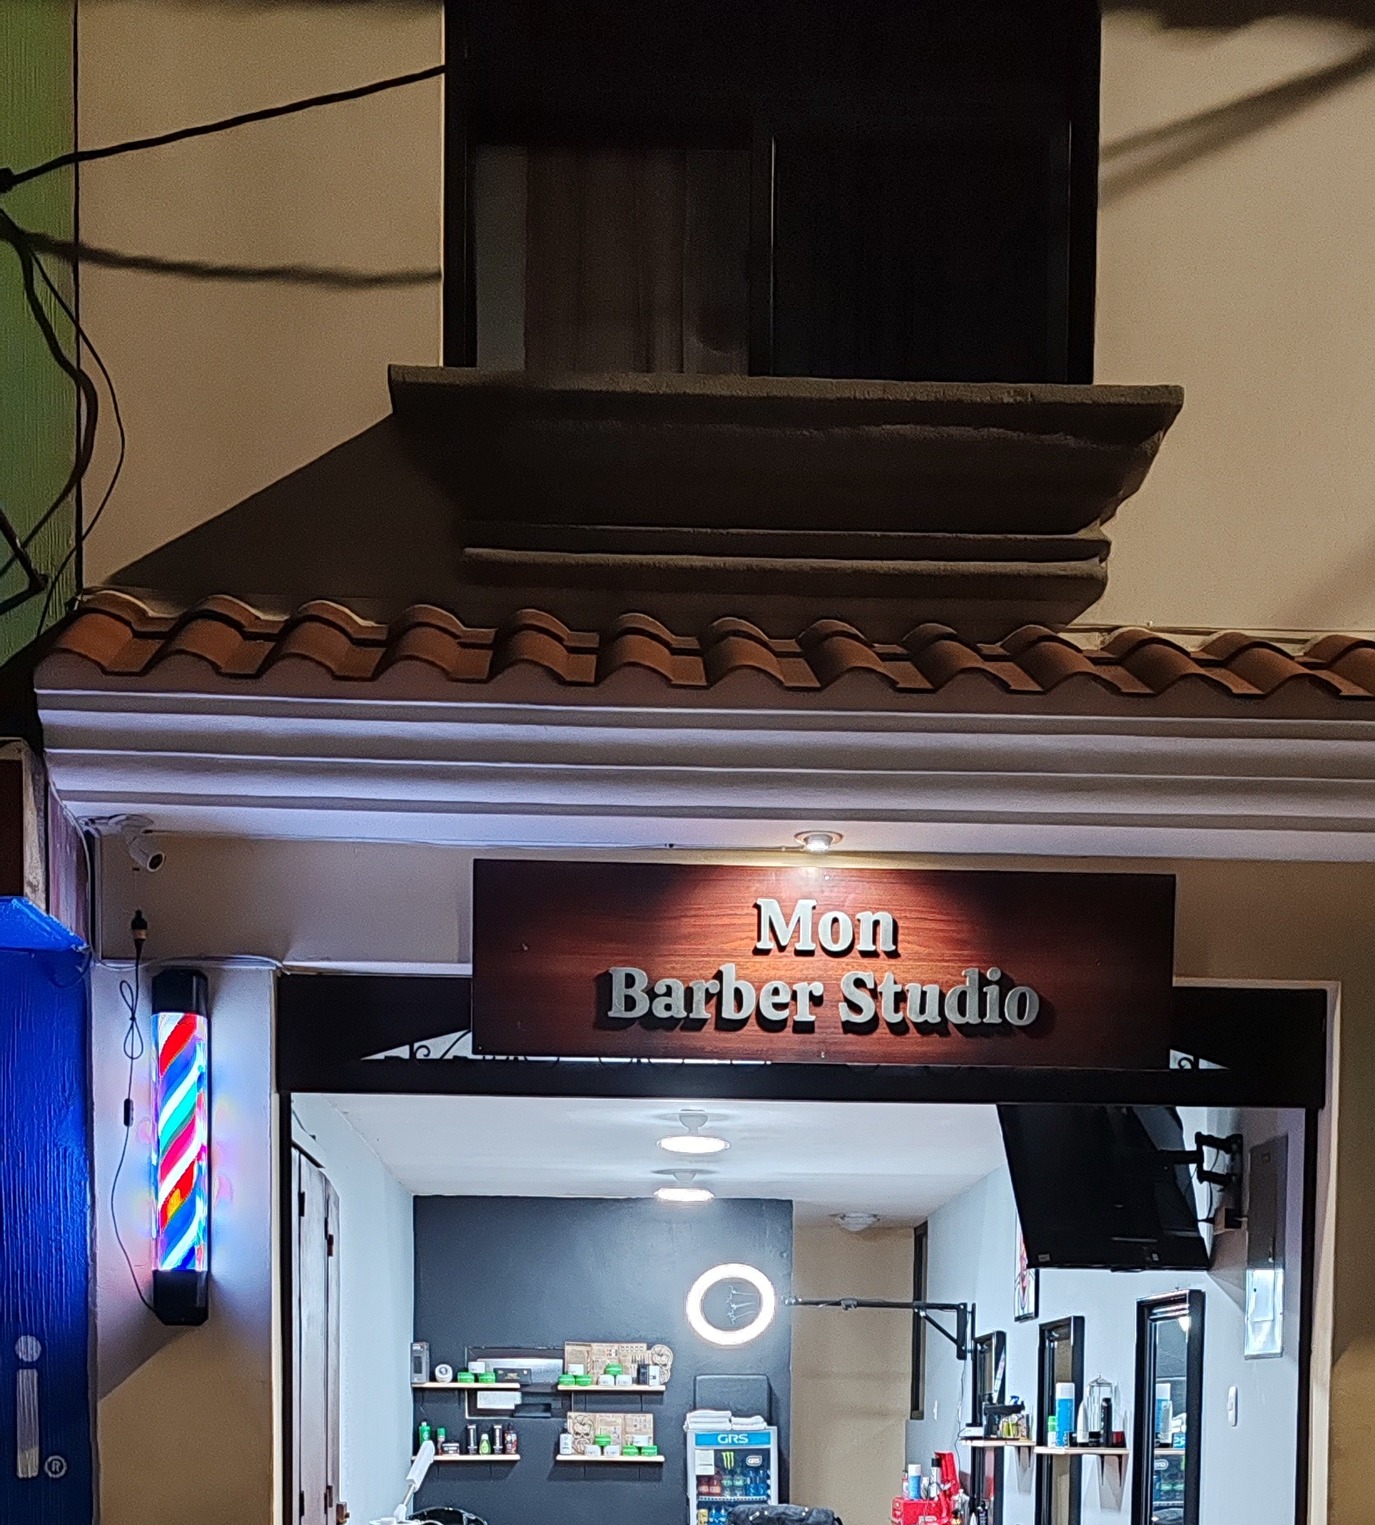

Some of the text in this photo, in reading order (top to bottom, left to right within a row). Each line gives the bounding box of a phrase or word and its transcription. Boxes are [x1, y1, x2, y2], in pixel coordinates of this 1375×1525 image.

[756, 898, 897, 953] Mon
[607, 963, 1041, 1026] Barber Studio
[717, 1433, 749, 1444] GRS
